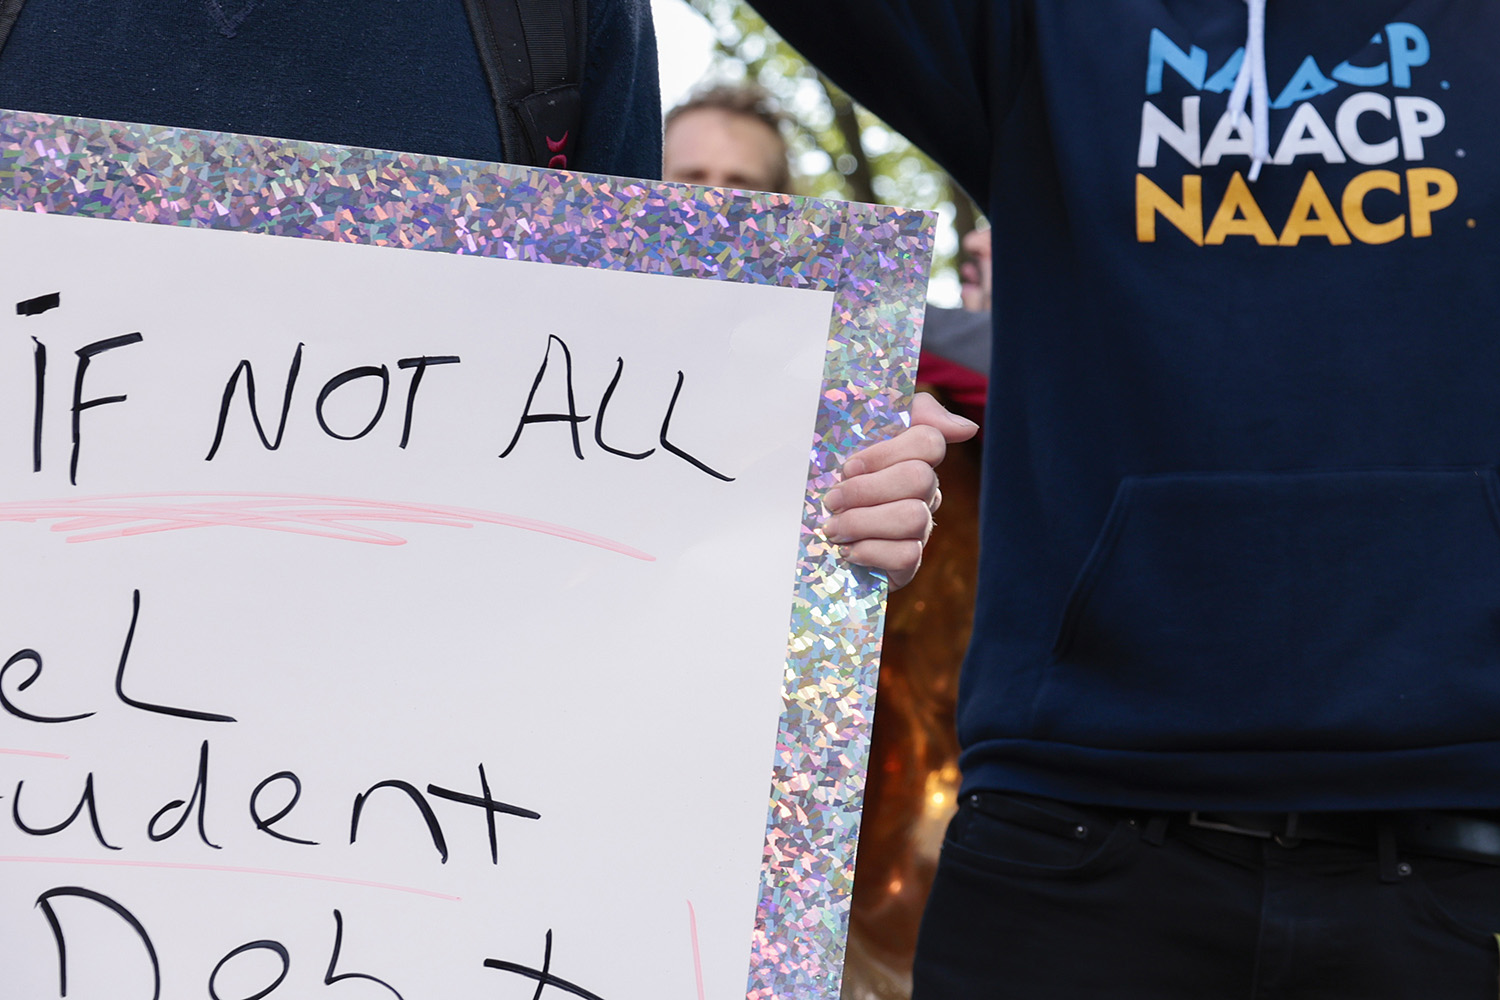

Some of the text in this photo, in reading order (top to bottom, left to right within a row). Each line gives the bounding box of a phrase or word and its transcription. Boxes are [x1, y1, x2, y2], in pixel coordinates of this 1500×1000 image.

[1137, 92, 1446, 168] NAACP
[1135, 166, 1459, 247] NAACP
[205, 341, 462, 462] NOT
[498, 333, 737, 483] ALL
[0, 739, 542, 865] udent
